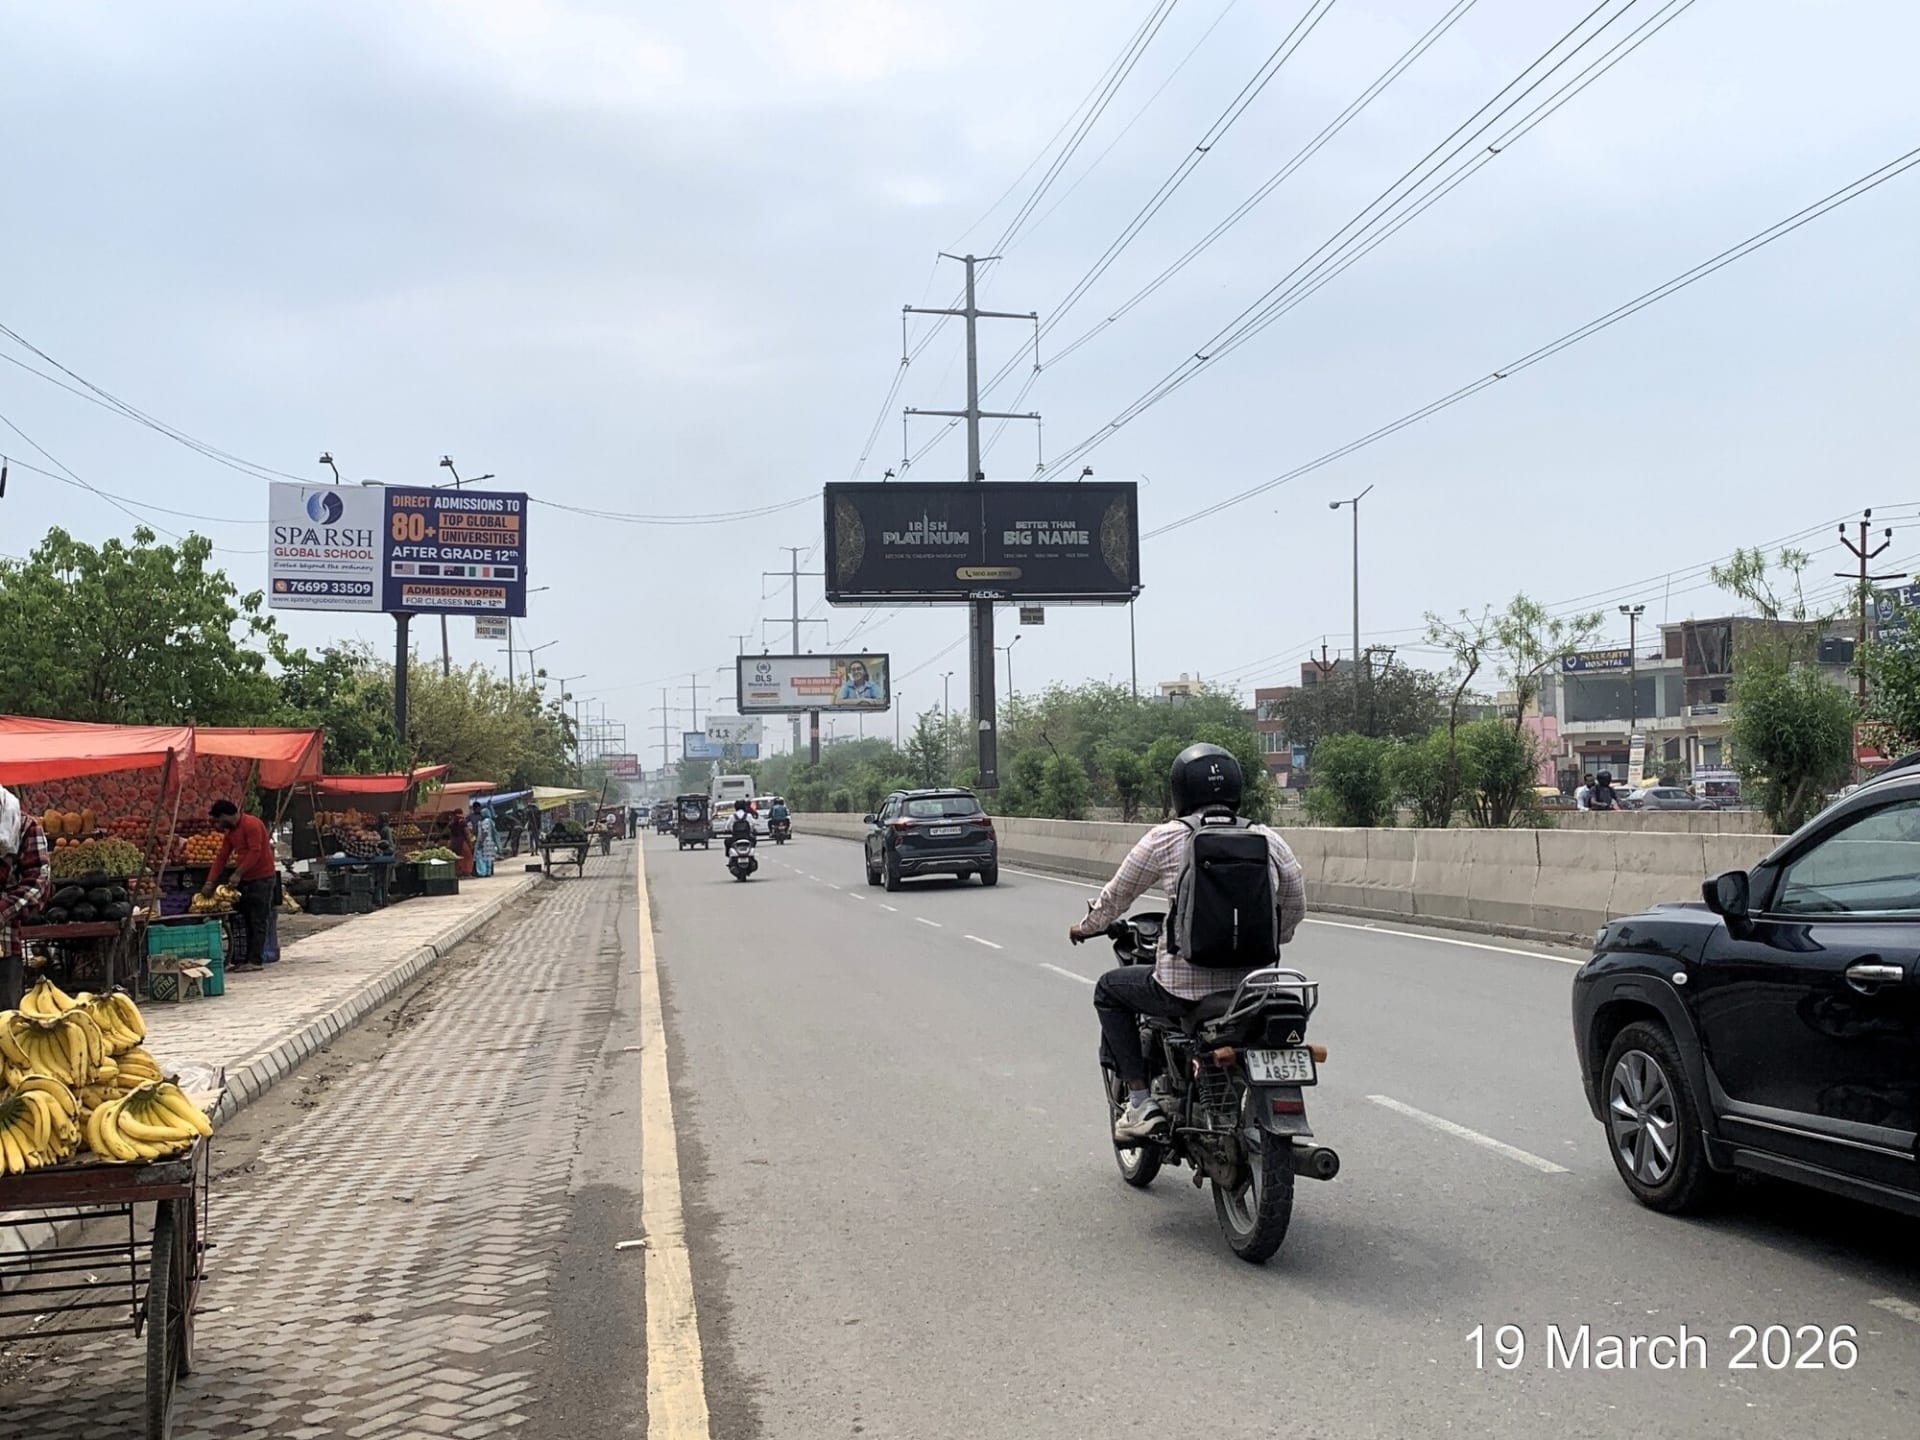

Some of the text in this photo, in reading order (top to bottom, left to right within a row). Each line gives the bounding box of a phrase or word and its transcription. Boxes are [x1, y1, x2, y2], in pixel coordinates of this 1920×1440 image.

[392, 495, 520, 512] DIRECT ADMISSIONS TO
[392, 512, 436, 542] 80+
[442, 514, 508, 528] TOP GLOBAL
[908, 518, 948, 531] IRISH
[1015, 521, 1076, 529] BETTER THAN
[441, 530, 516, 545] UNIVERSITIES
[882, 531, 970, 545] PLATINUM
[1003, 531, 1090, 545] BIG NAME
[274, 547, 374, 560] GLOBAL SCHOOL
[392, 546, 519, 561] AFTER GRADE 12th
[290, 581, 371, 594] 76699 33509
[407, 586, 502, 597] ADMISSIONS OPEN
[425, 597, 464, 605] CLASSES
[1265, 1065, 1308, 1080] A8575
